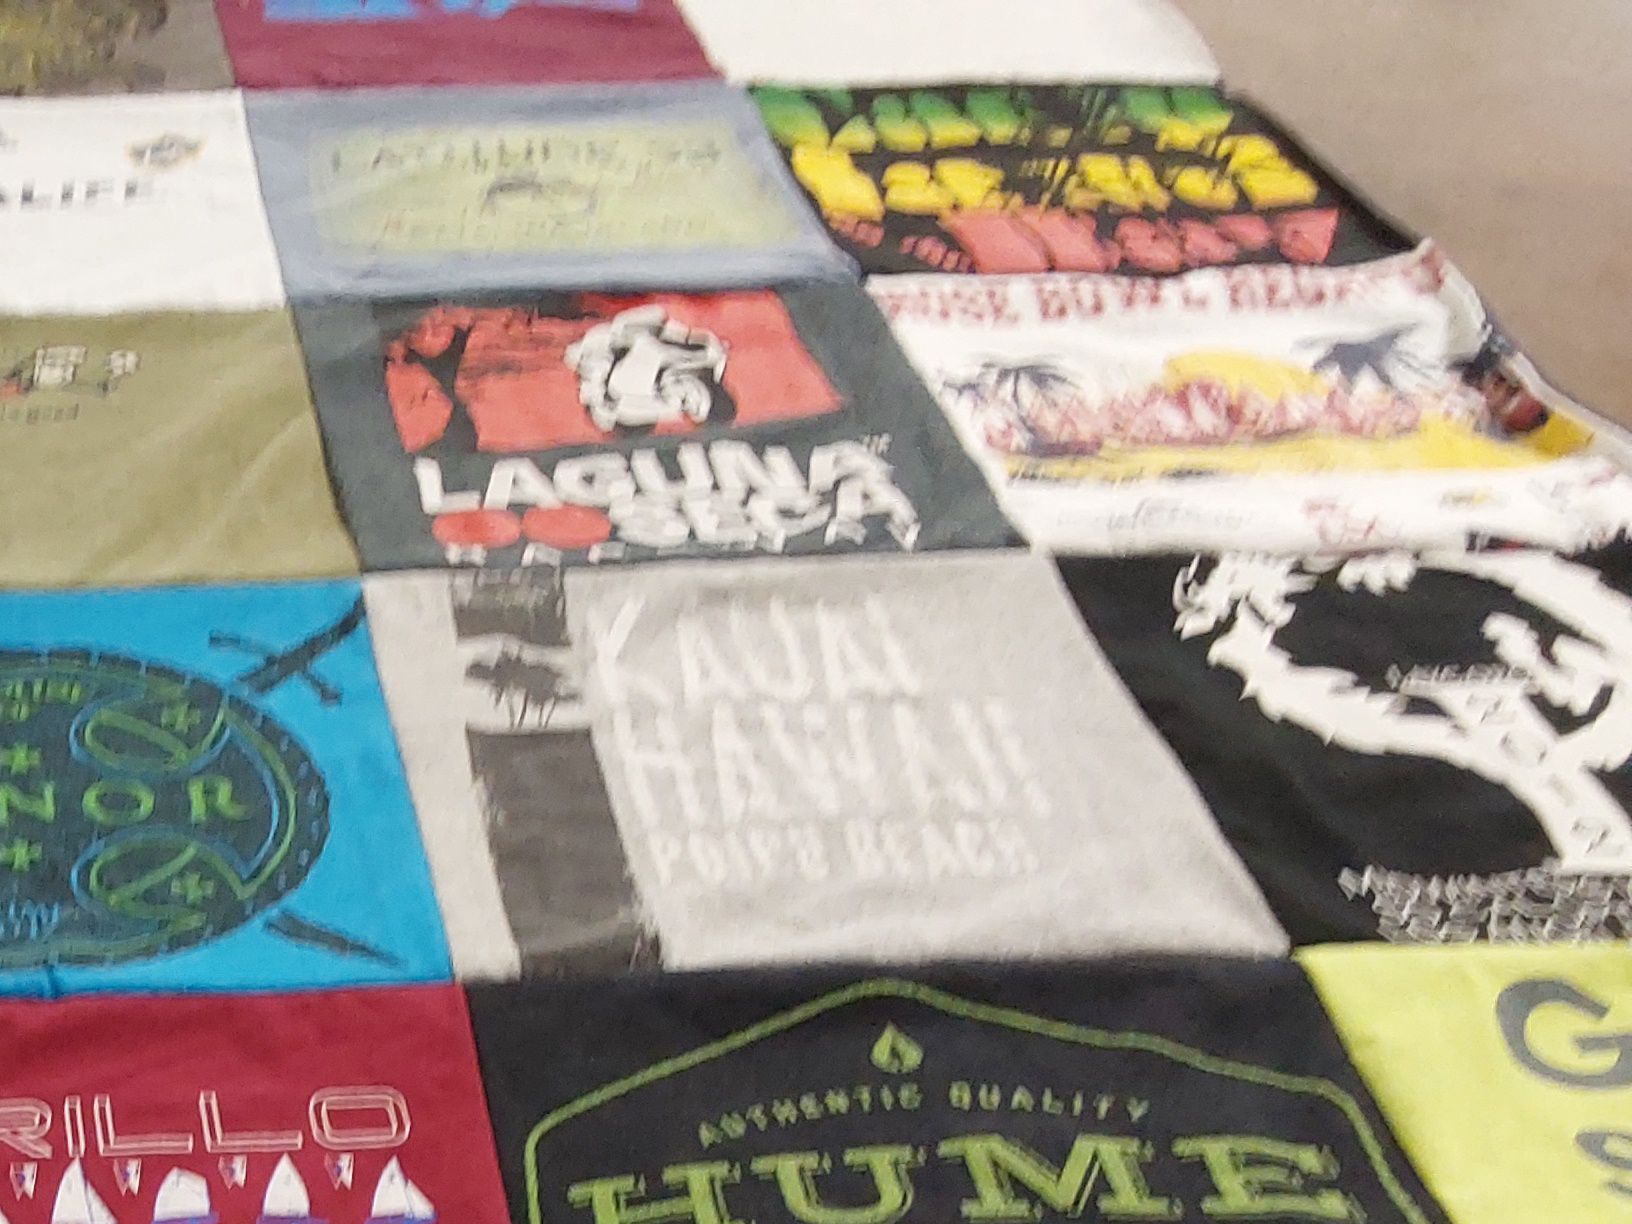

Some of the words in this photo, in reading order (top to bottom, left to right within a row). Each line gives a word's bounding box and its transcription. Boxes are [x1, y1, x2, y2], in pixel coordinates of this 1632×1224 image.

[413, 438, 898, 516] LAGUNA
[698, 1081, 923, 1151] AUTHENTIC
[948, 1079, 1151, 1124] QUALITY
